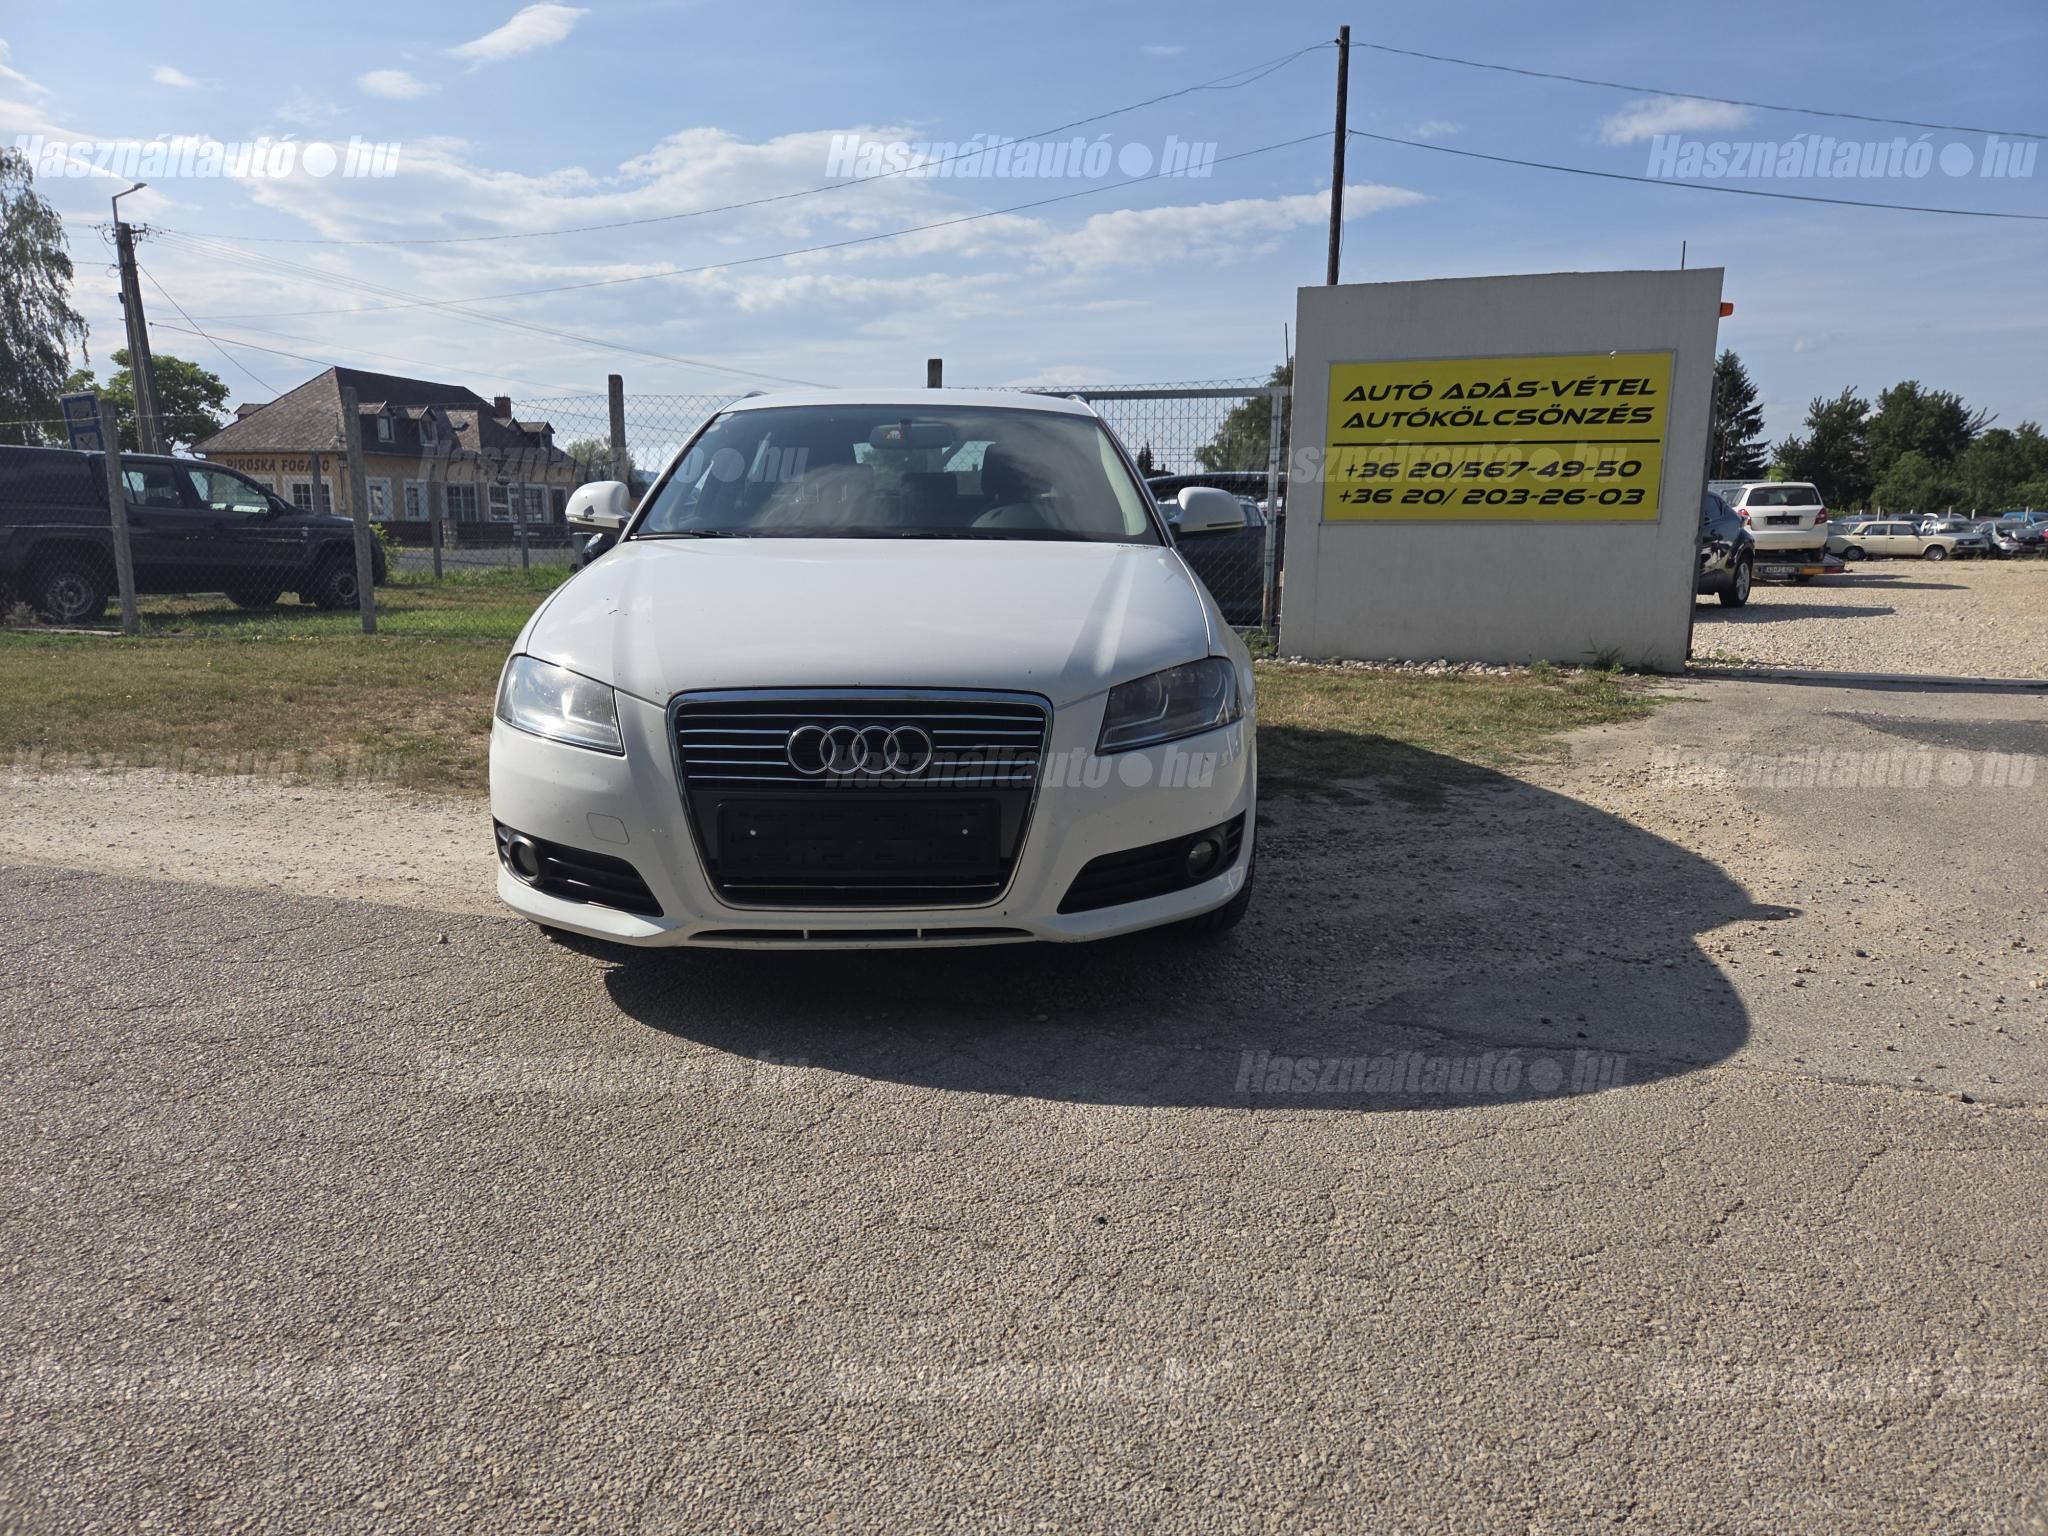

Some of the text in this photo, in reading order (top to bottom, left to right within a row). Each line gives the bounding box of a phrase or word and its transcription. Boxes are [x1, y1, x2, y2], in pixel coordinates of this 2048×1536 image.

[1343, 376, 1657, 401] AUTÓ ADÁS-VÉTEL
[1341, 403, 1656, 429] AUTÓKÖLCSÖNZÉS
[281, 456, 330, 472] FOGAÓ
[1345, 460, 1642, 479] +36 20/567-49-50
[1338, 488, 1646, 505] +36 20/ 203-26-03
